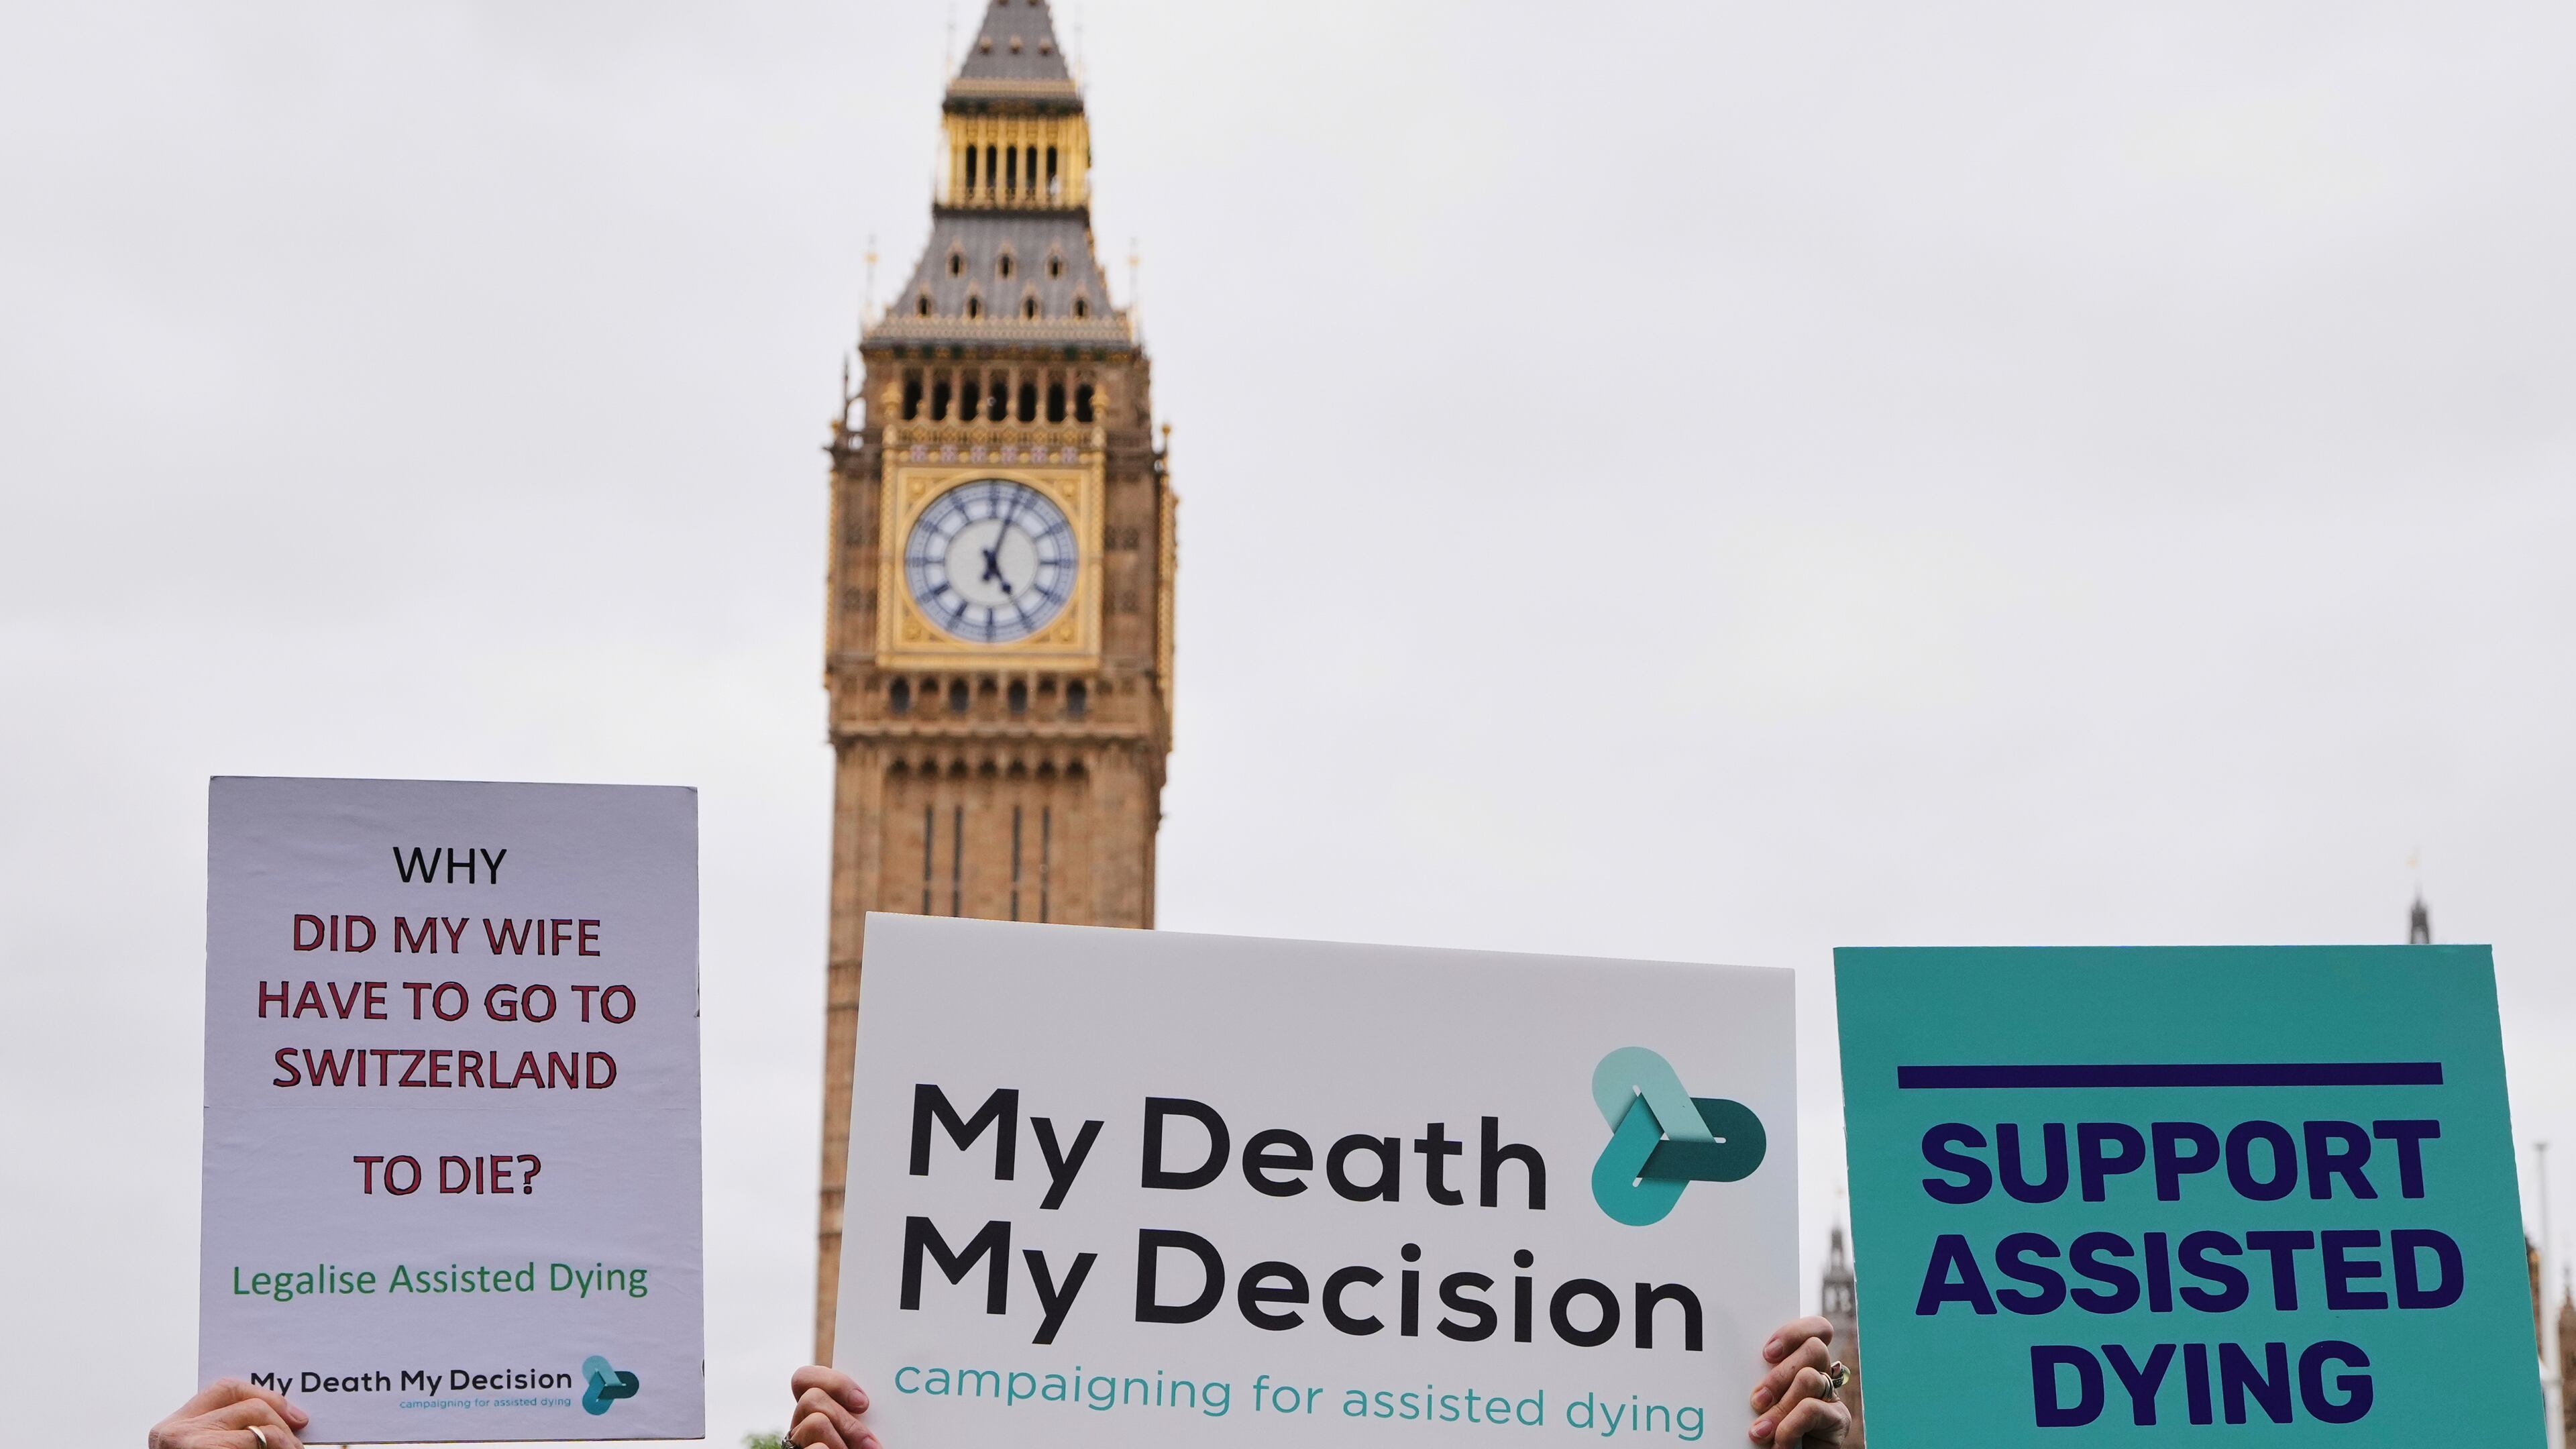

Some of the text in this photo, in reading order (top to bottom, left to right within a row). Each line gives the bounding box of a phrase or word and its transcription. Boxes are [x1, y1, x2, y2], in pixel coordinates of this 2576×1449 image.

[393, 847, 506, 884] WHY
[294, 914, 600, 957] DID MY WIFE
[258, 981, 636, 1024] HAVE TO GO TO
[273, 1047, 616, 1089] SWITZERLAND
[910, 1083, 1546, 1210] My Death
[1921, 1120, 2440, 1205] SUPPORT
[354, 1155, 541, 1195] TO DIE?
[234, 1262, 648, 1301] Legalise Assisted Dying
[900, 1216, 1703, 1351] My Decision
[1915, 1229, 2464, 1316] ASSISTED
[251, 1368, 572, 1397] My Death My Decision
[398, 1397, 572, 1409] campaigning for assisted dying
[895, 1366, 1703, 1441] campaigning for assisted dying
[2031, 1340, 2373, 1428] DYING
